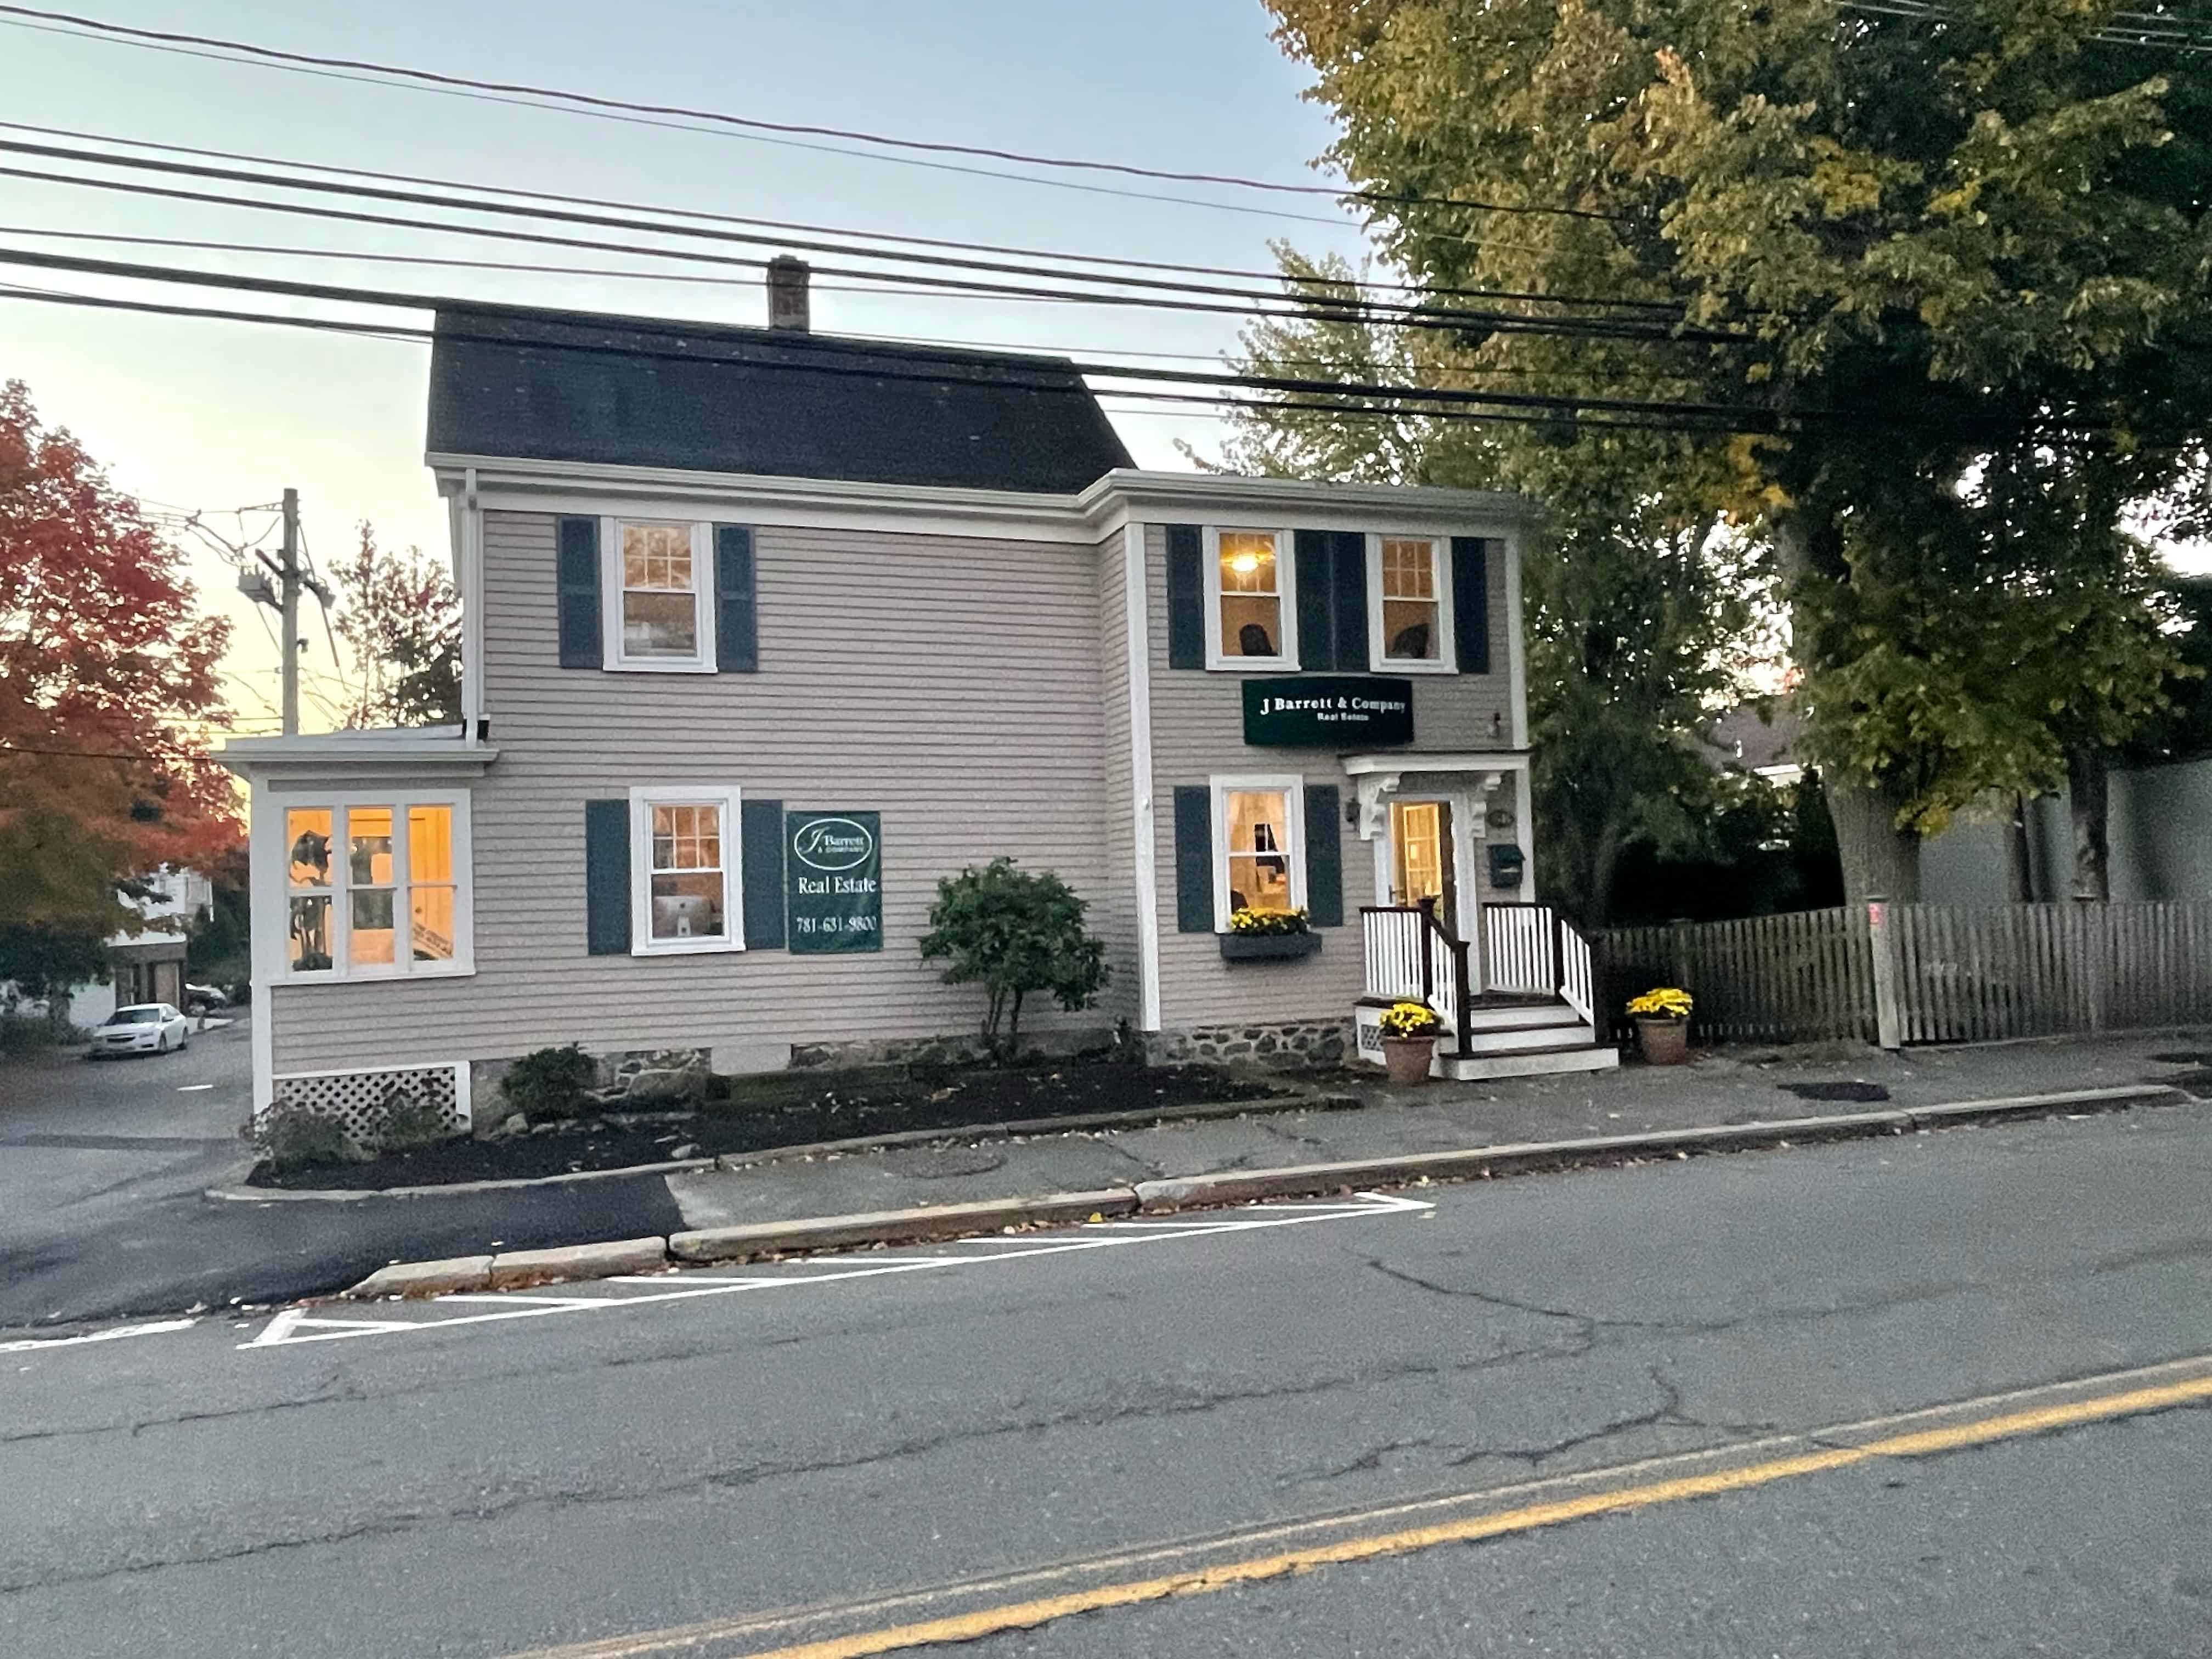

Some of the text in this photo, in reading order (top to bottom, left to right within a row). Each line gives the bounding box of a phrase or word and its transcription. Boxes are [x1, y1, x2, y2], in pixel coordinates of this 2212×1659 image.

[1260, 697, 1406, 715] J Barrett & Company
[1317, 713, 1339, 721] Real
[798, 826, 865, 854] J Barrett
[798, 876, 877, 894] Real Estate
